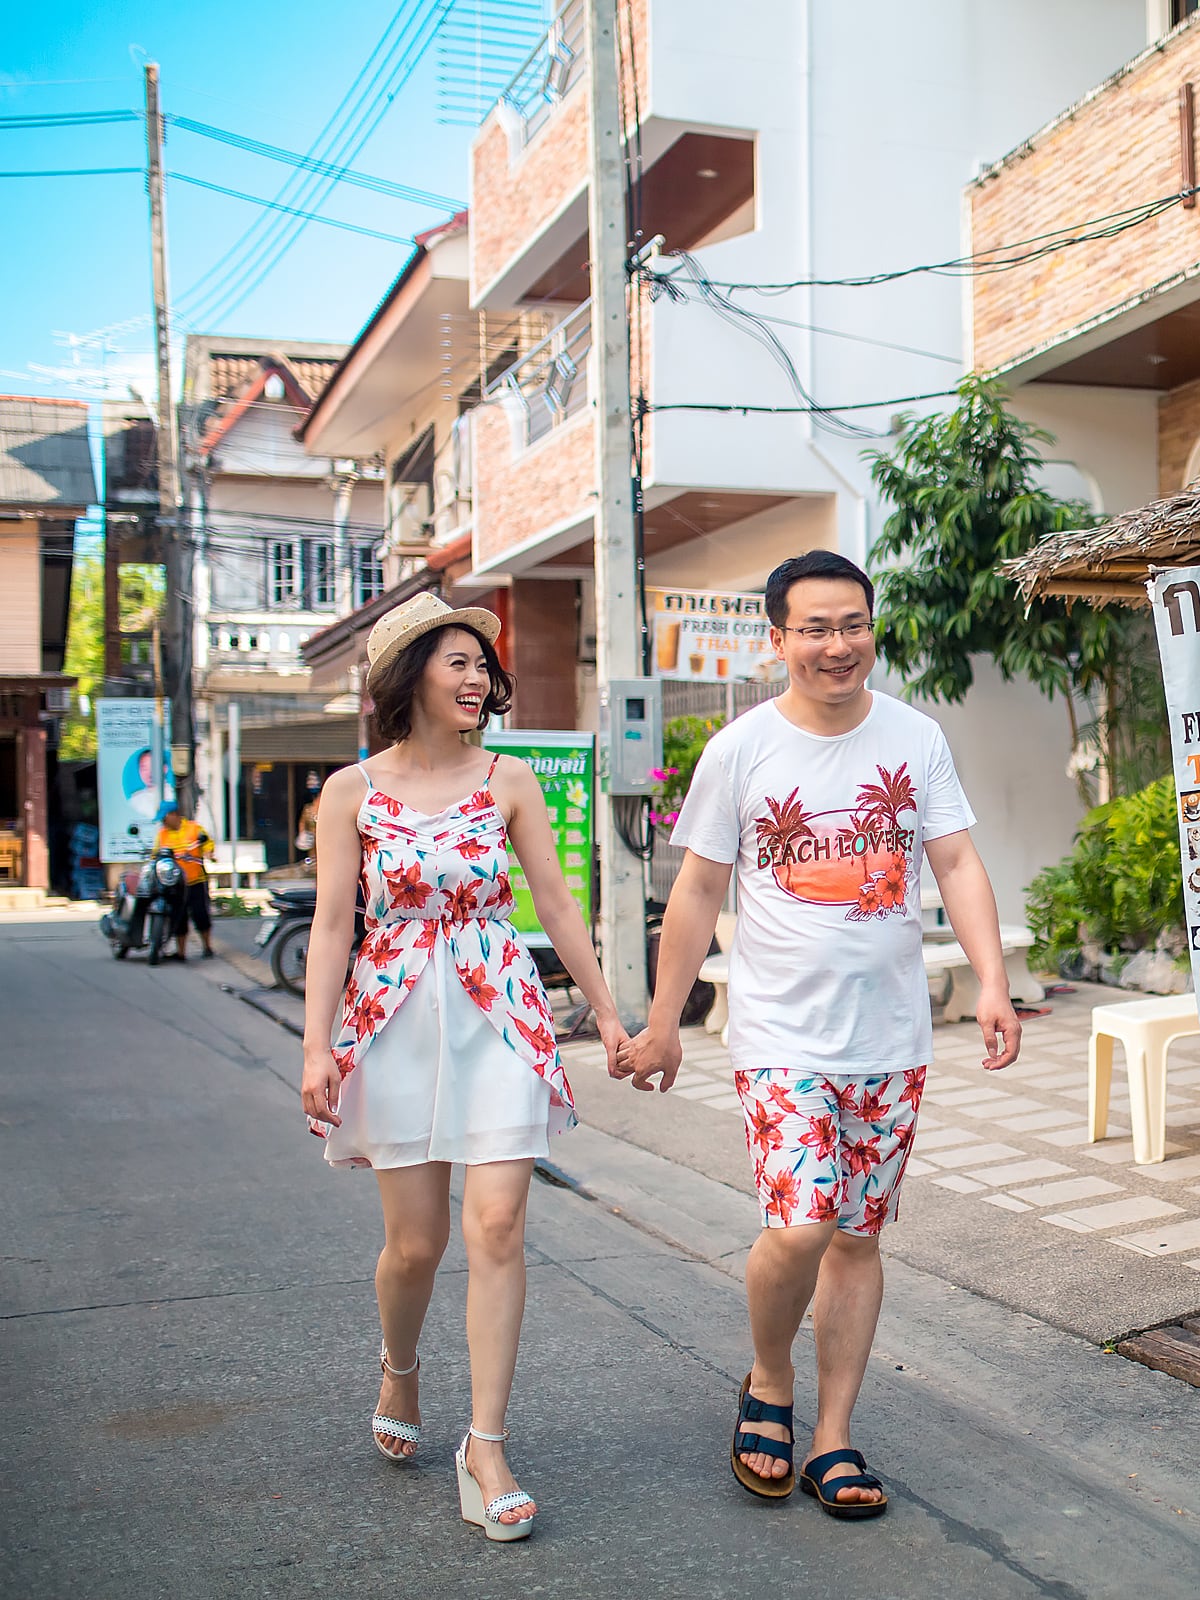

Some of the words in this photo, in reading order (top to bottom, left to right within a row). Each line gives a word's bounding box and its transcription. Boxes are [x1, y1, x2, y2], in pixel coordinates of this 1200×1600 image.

[665, 595, 760, 614] กาแฟส
[682, 620, 728, 634] FRESH
[696, 638, 739, 652] THAI
[746, 640, 772, 654] TE
[758, 837, 830, 870] BEACH
